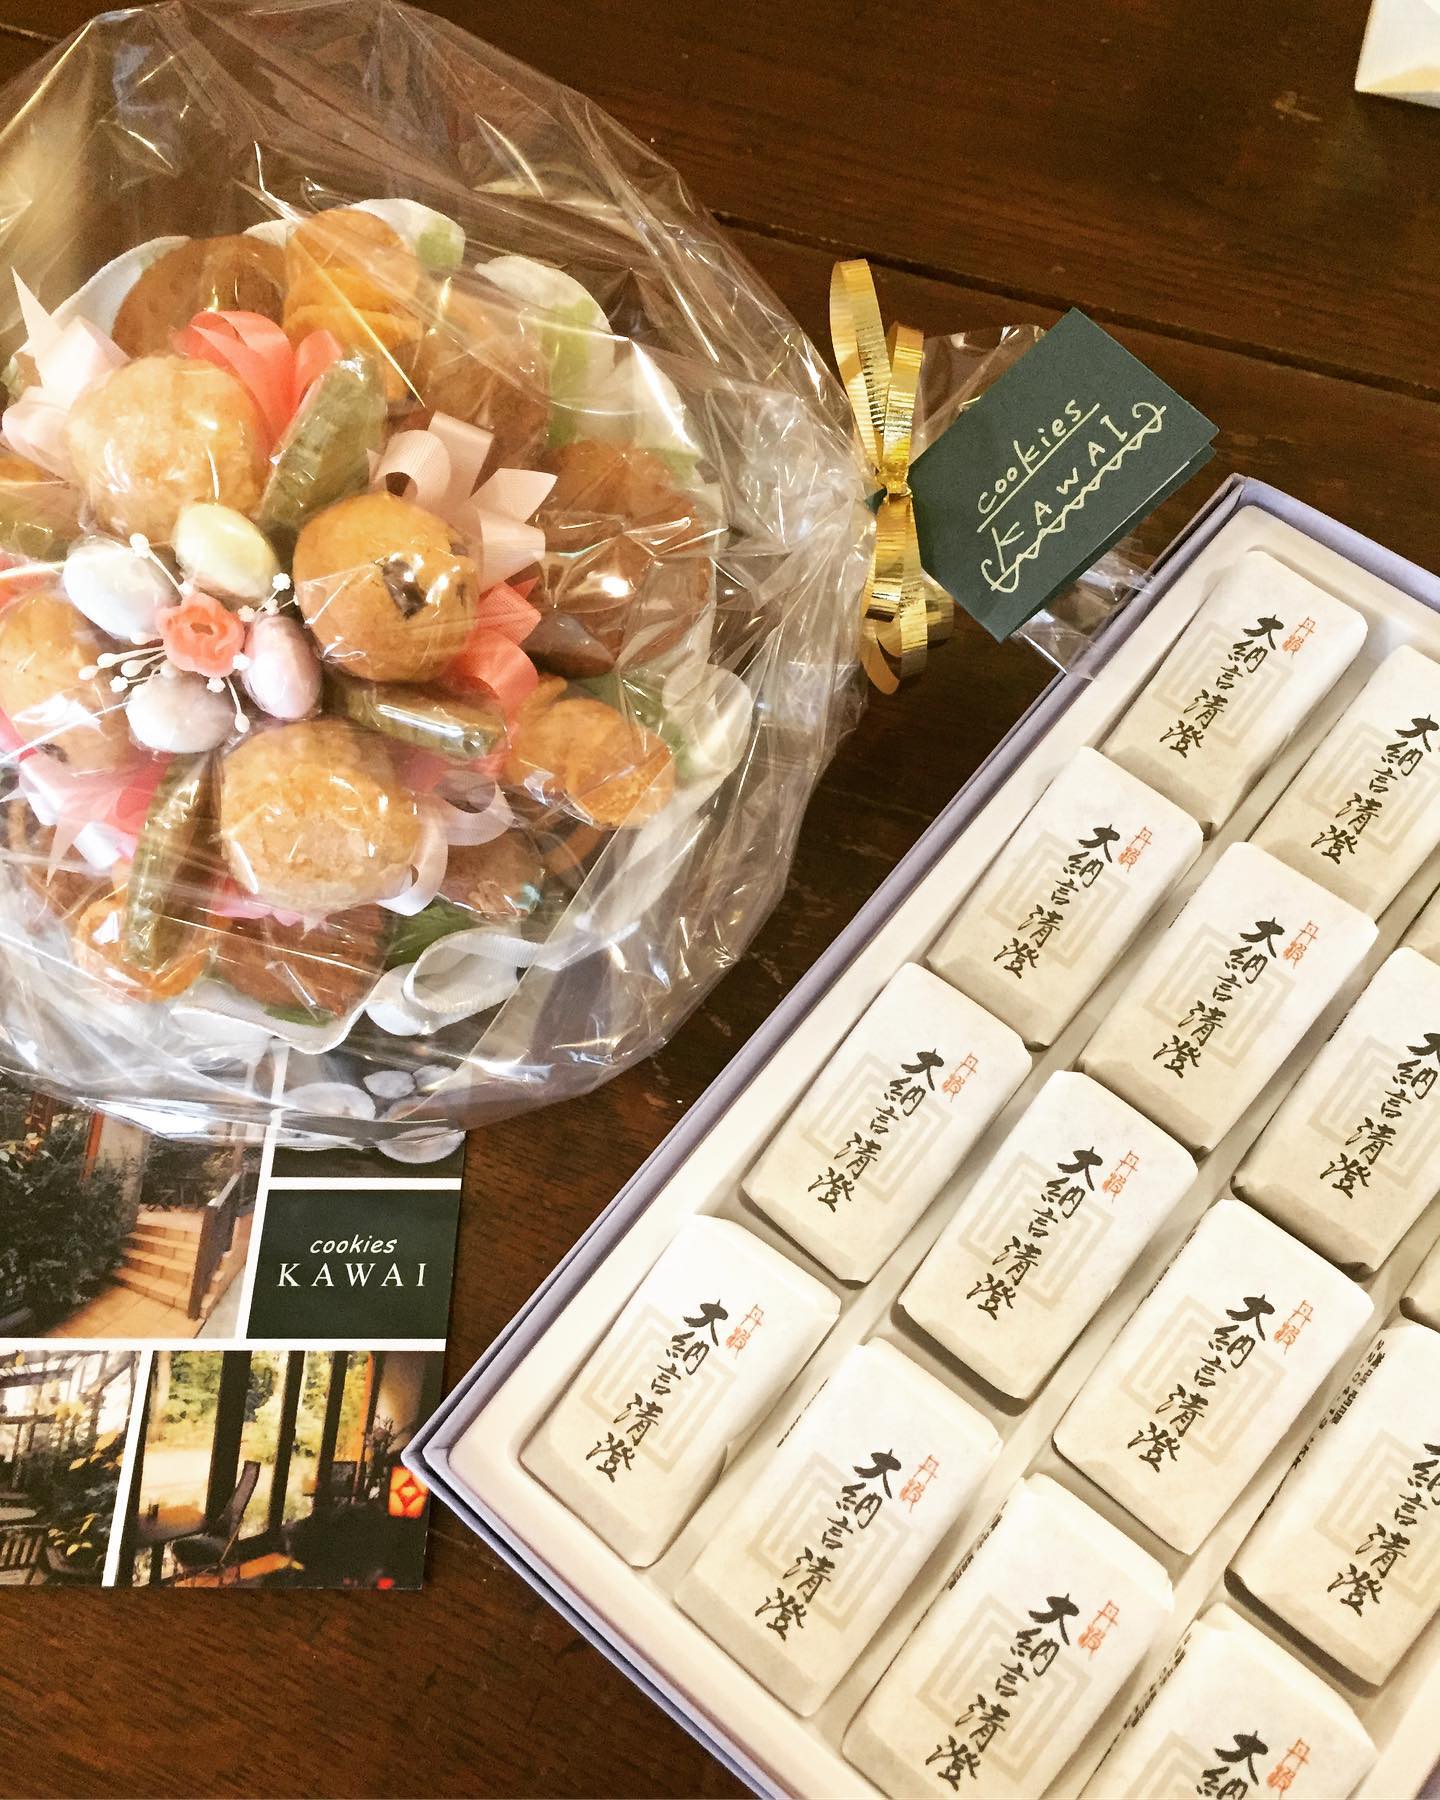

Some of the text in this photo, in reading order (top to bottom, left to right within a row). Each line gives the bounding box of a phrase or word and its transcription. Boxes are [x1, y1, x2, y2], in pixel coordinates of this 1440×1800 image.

[978, 399, 1082, 514] cookies
[991, 414, 1128, 573] KAWAI
[1160, 615, 1284, 758] 大納言清澄
[1311, 714, 1440, 865] 大納言清澄
[994, 825, 1121, 979] 大納言清澄
[1153, 918, 1285, 1079] 大納言清澄
[808, 1049, 945, 1213] 大納言清澄
[276, 1262, 428, 1287] KAWAI
[310, 1233, 398, 1254] cookies
[967, 1147, 1103, 1321] 大納言清澄
[586, 1300, 728, 1483] 大納言清澄
[1128, 1295, 1275, 1473] 大納言清澄
[755, 1450, 902, 1641] 大納言清澄
[926, 1594, 1080, 1791] 大納言清澄
